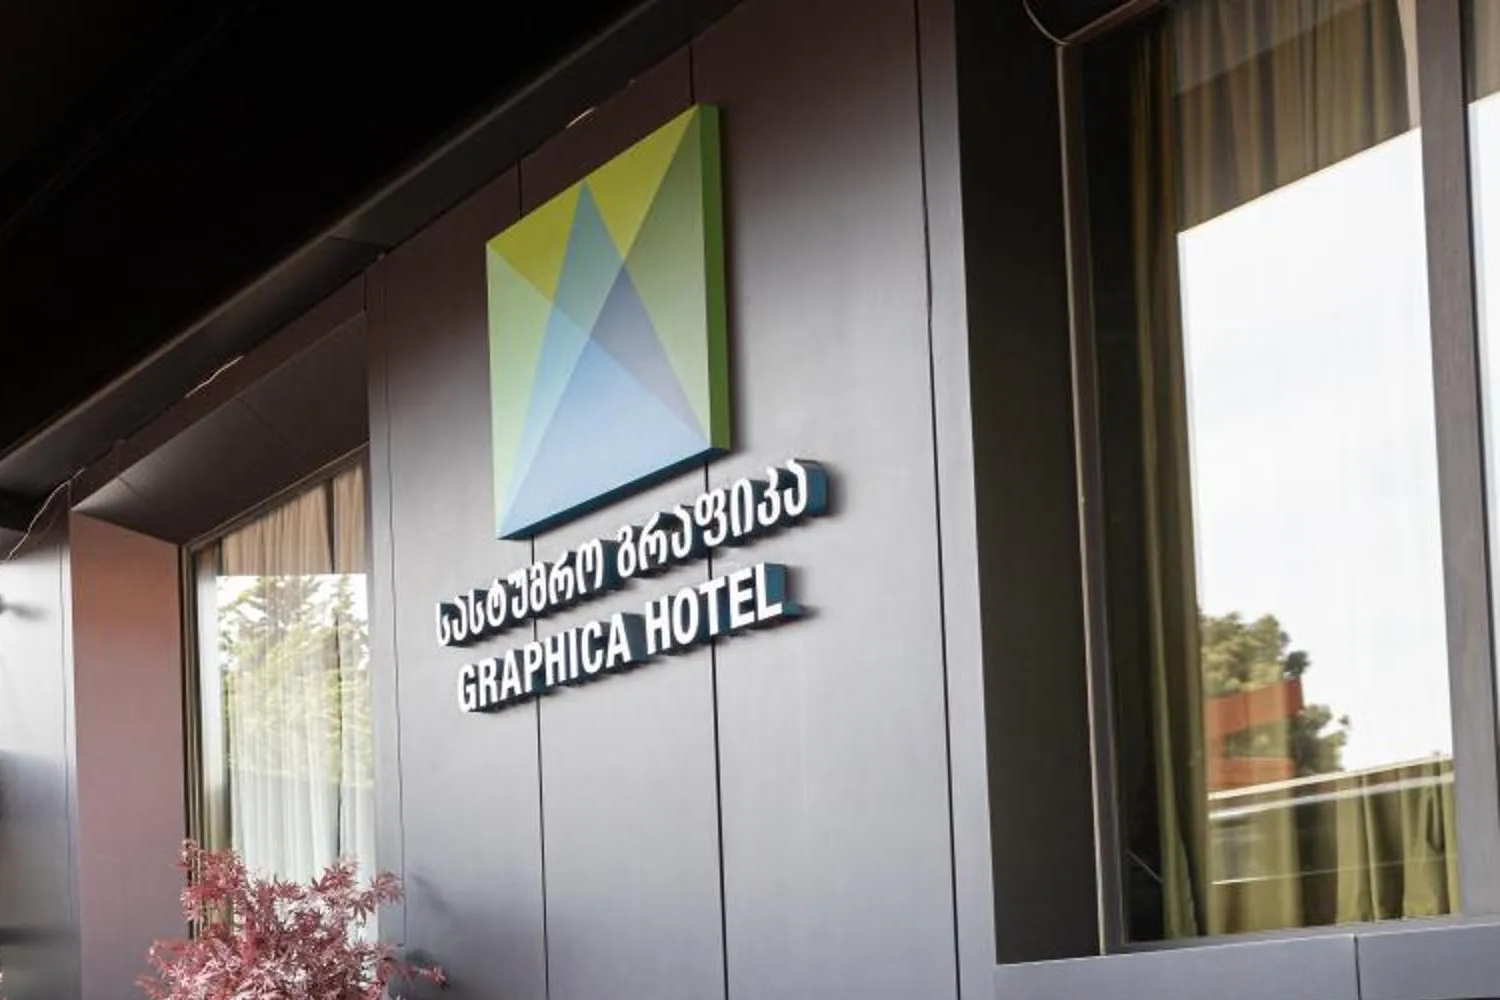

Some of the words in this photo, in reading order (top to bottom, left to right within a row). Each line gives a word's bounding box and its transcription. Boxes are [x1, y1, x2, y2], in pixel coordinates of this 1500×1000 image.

[435, 538, 603, 647] სასტუმრო
[616, 458, 808, 578] გრაფიკა
[457, 612, 633, 713] GRAPHICA
[644, 562, 783, 655] HOTEL
